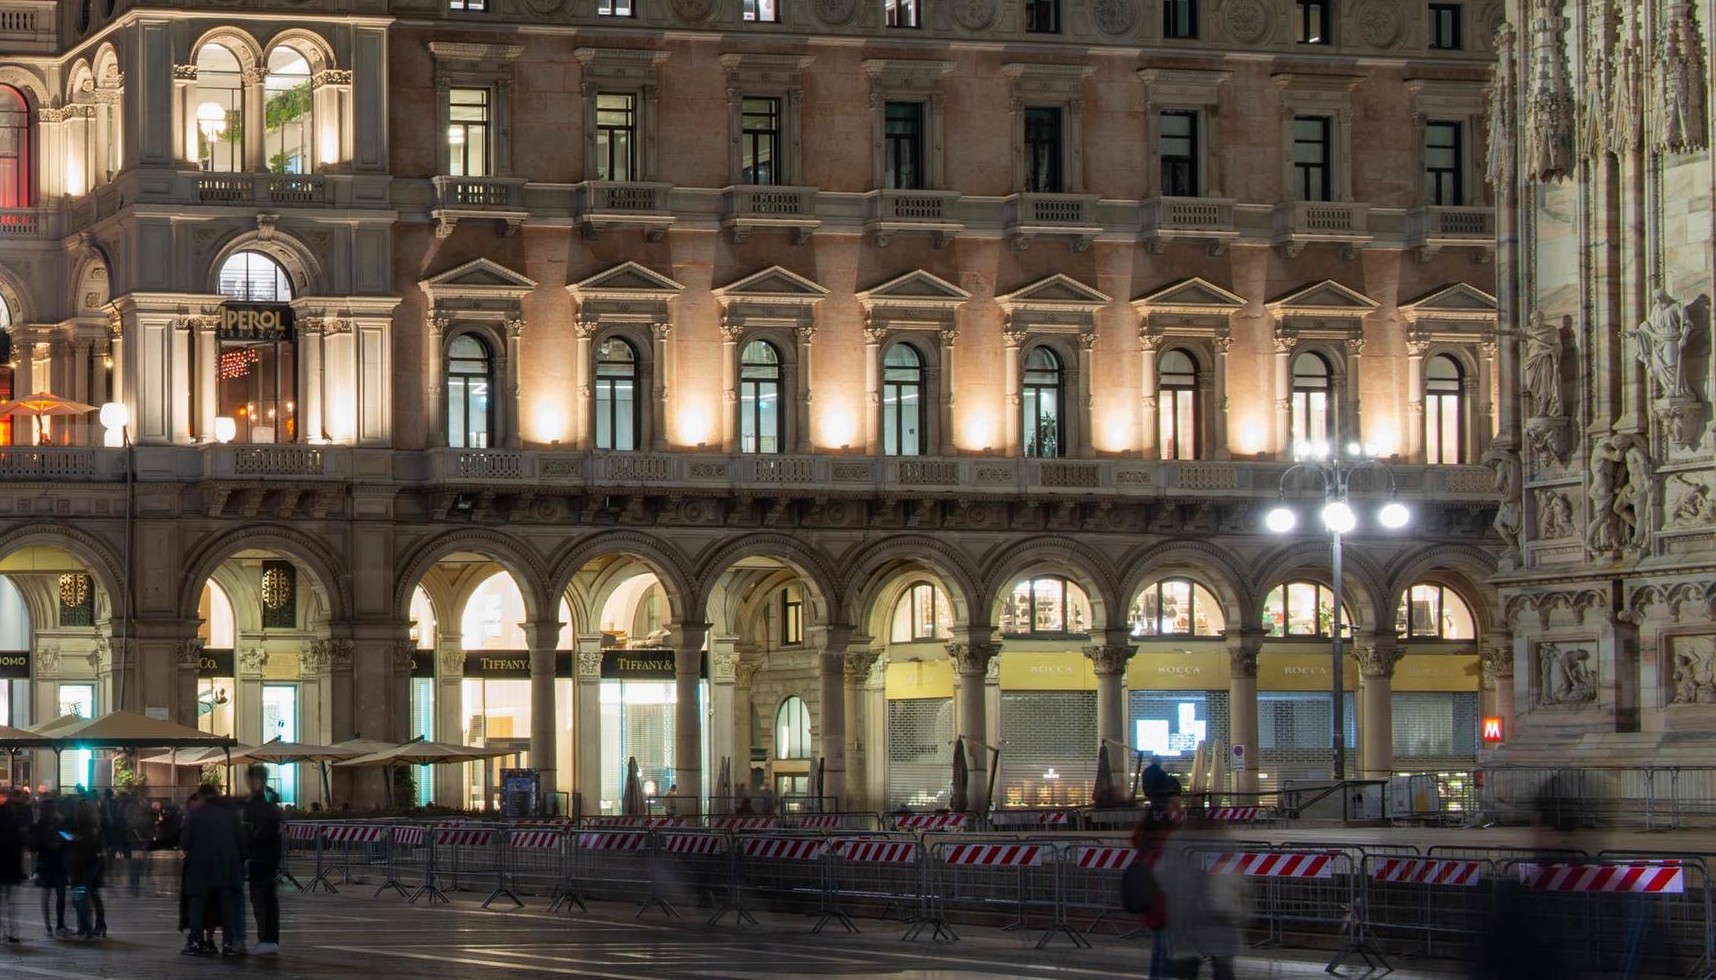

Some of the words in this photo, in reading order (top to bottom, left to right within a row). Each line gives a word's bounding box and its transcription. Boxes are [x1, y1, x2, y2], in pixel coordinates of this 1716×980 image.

[220, 330, 286, 339] ERRAZZA
[479, 657, 527, 670] TIFFANY
[617, 657, 664, 670] TIFFANY
[1157, 666, 1201, 675] ROCCA
[1284, 666, 1326, 675] ROCCA
[1484, 722, 1501, 739] M
